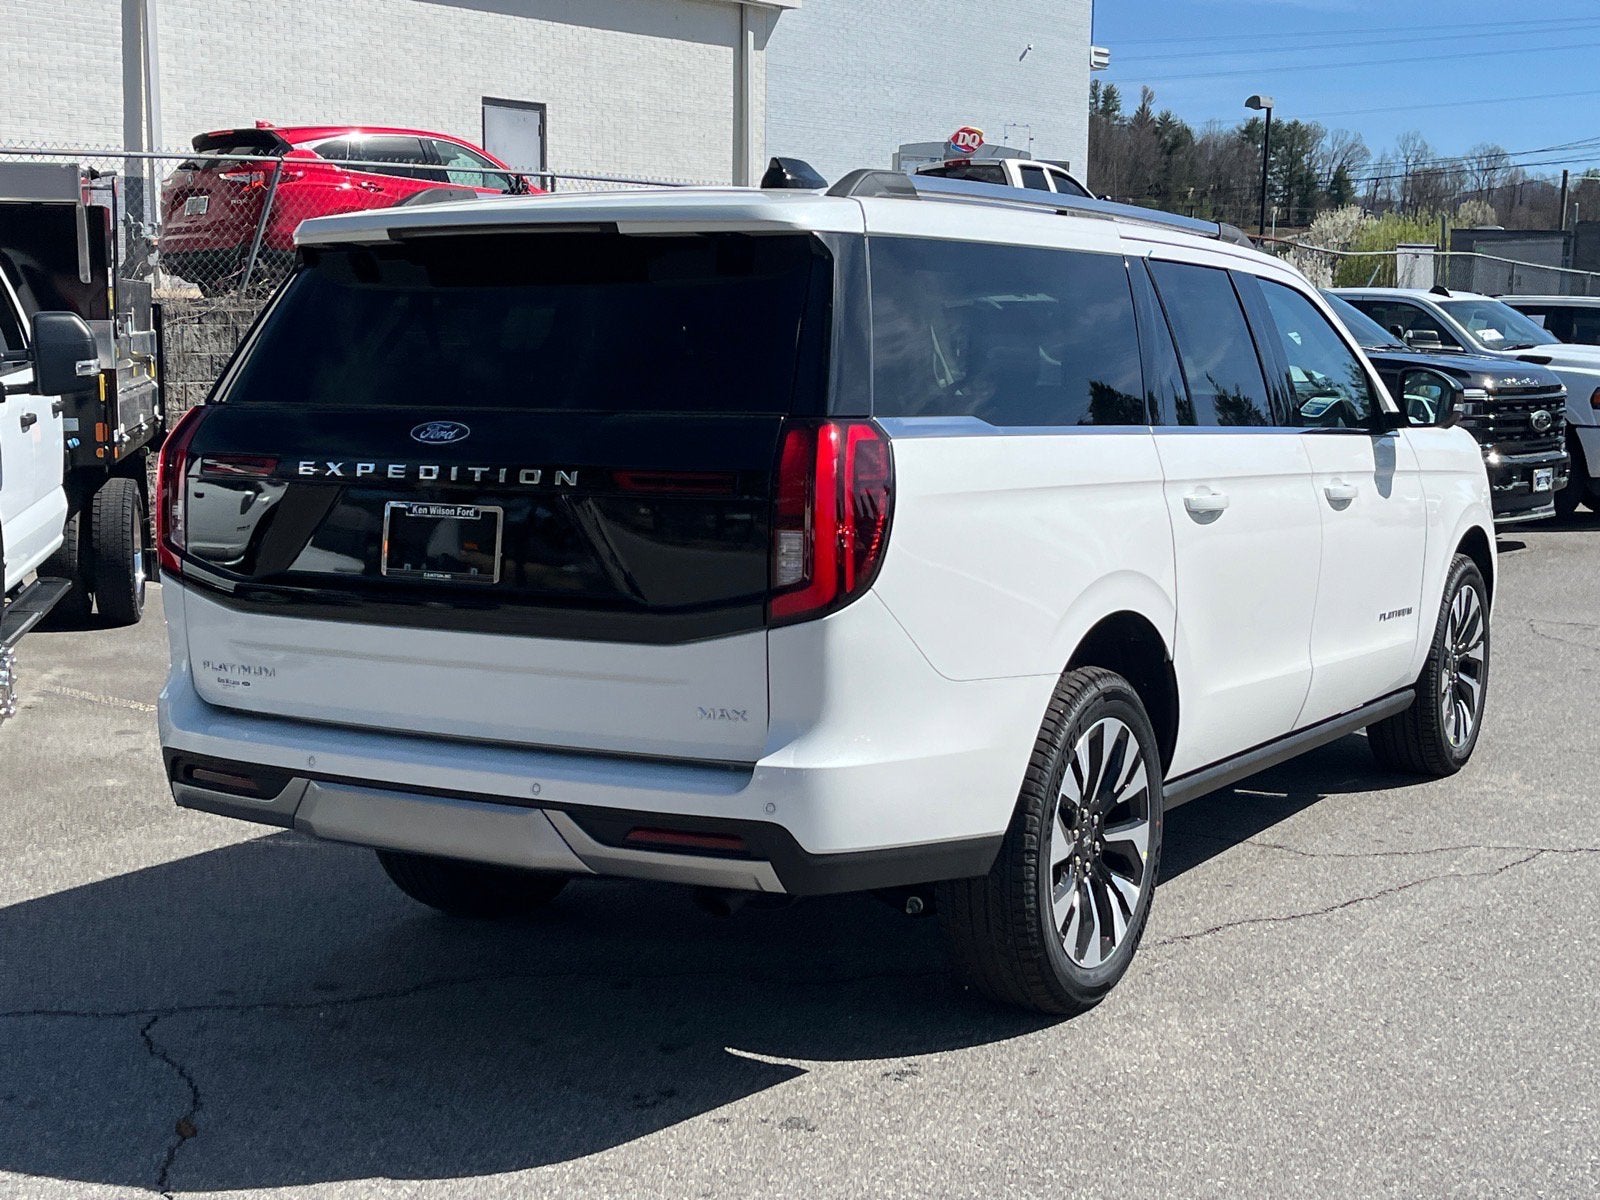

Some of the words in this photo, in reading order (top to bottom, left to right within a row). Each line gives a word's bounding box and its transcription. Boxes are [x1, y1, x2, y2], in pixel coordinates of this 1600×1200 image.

[957, 132, 980, 149] DQ
[420, 424, 460, 440] Ford
[298, 460, 579, 487] EXPEDITION
[412, 505, 428, 514] Ken
[430, 506, 455, 516] Wilson
[456, 507, 475, 517] Ford
[202, 660, 276, 677] PLATINUM
[697, 706, 748, 721] MAX
